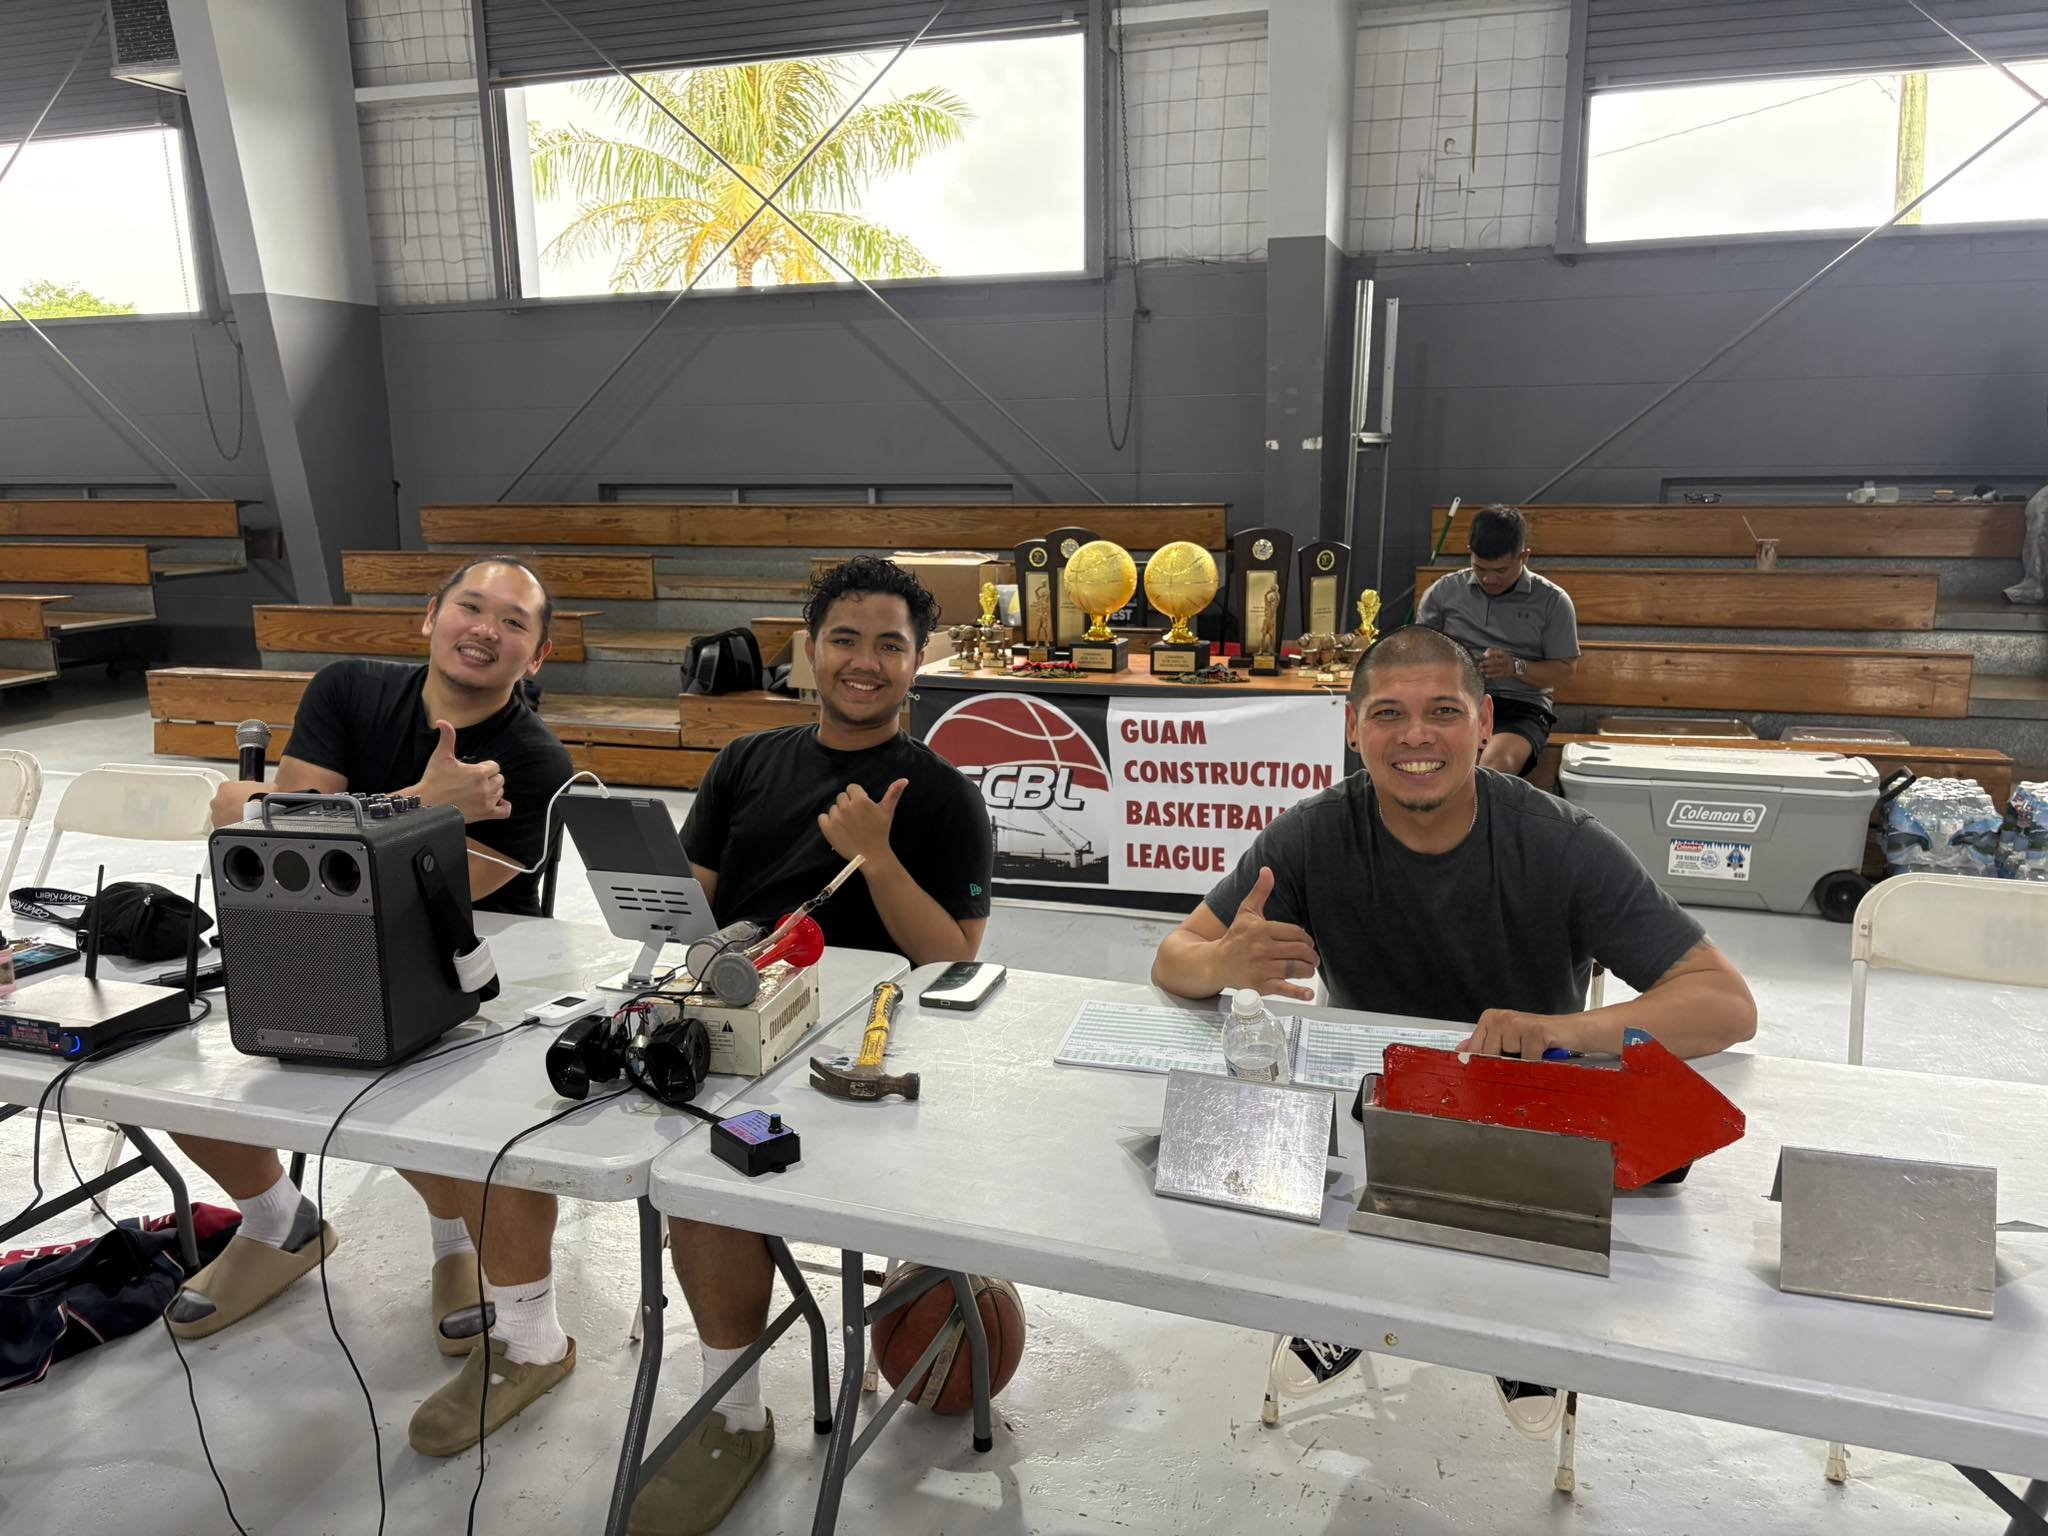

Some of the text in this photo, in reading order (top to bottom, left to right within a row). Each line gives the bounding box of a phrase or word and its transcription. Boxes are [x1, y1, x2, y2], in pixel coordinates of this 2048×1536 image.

[1111, 609, 1133, 621] EST
[1121, 719, 1207, 744] GUAM
[1124, 760, 1332, 789] CONSTRUCTION
[1126, 800, 1285, 830] BASKETBAL
[1679, 804, 1741, 822] Coleman
[1126, 843, 1225, 872] LEAGUE
[35, 891, 88, 903] Calvin Klein
[23, 903, 50, 918] Calvin
